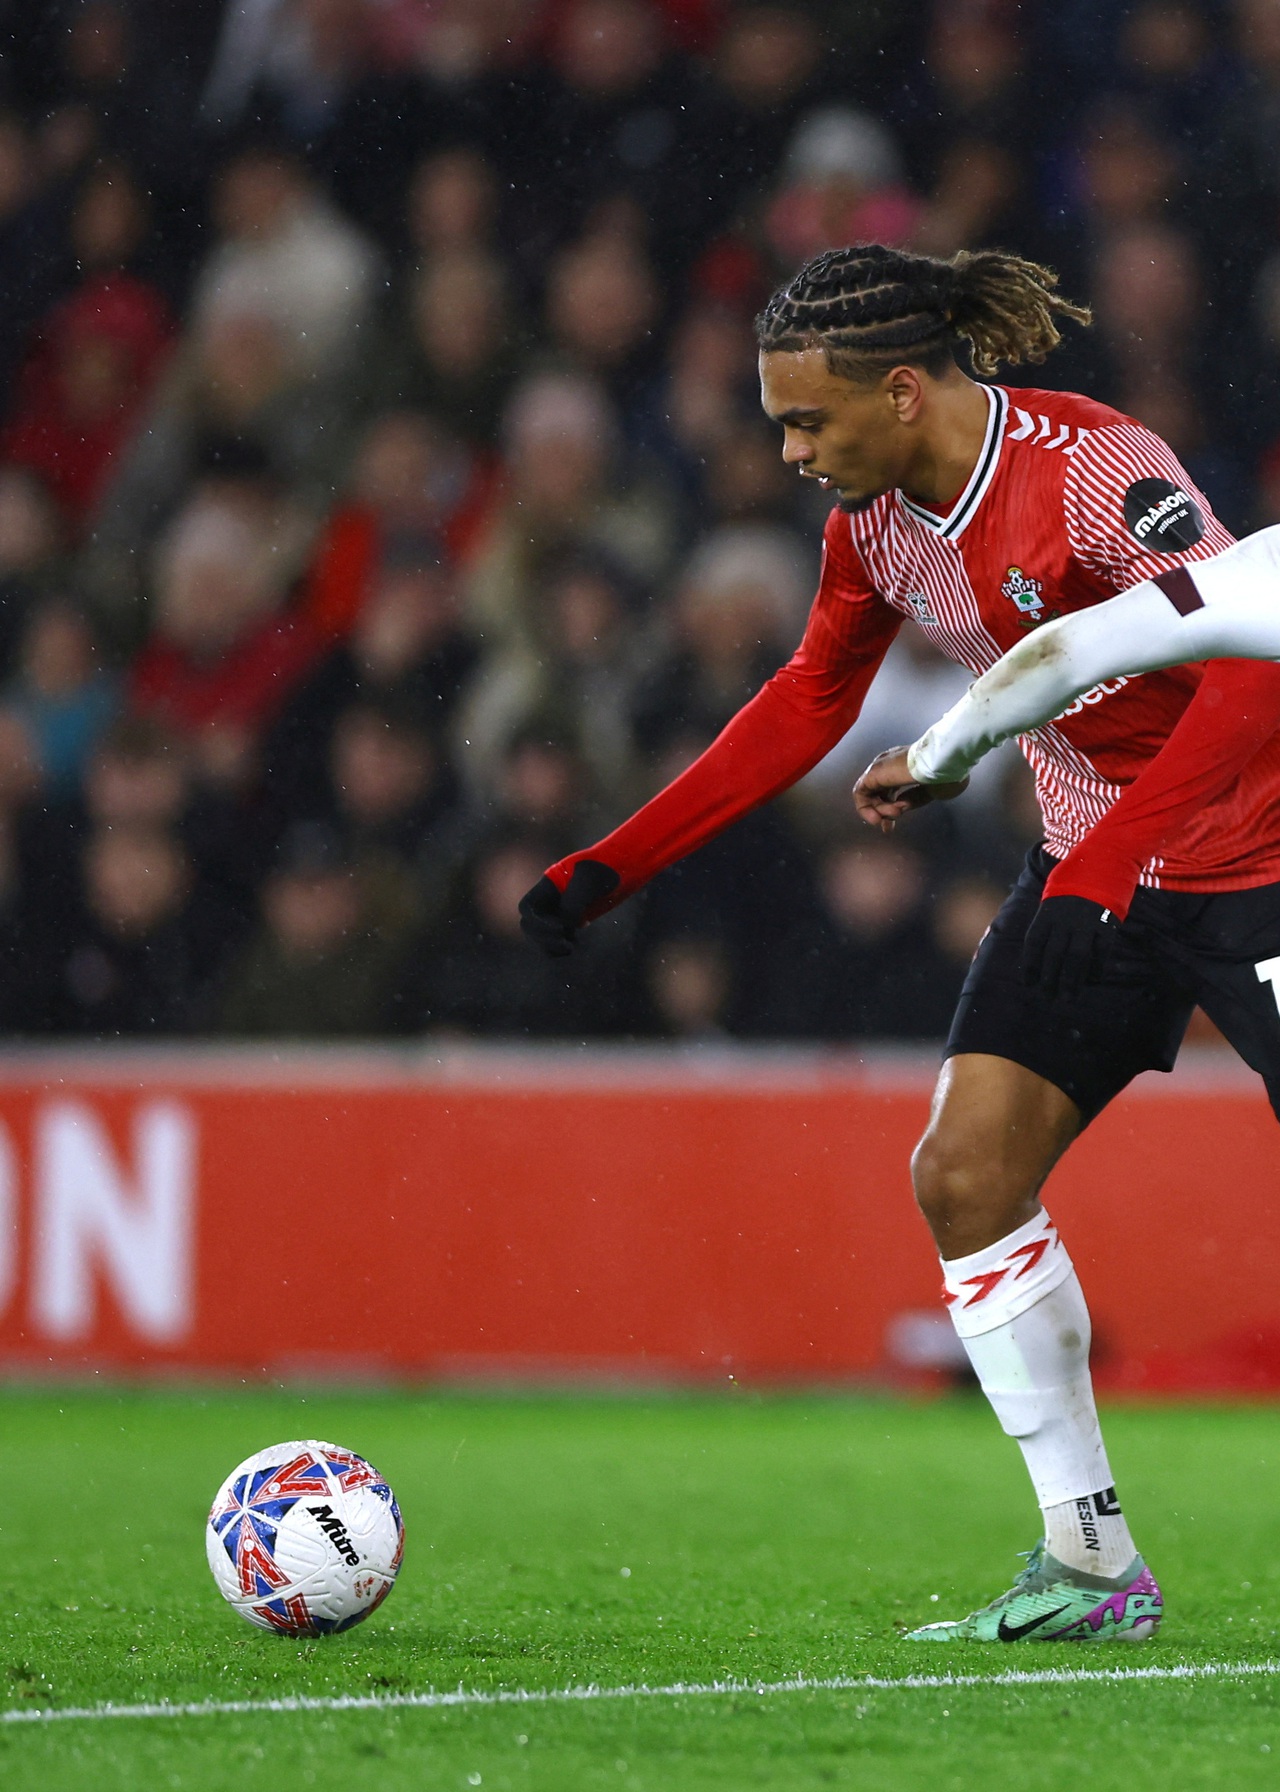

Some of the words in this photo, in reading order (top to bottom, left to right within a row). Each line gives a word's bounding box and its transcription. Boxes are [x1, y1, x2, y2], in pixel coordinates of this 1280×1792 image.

[1157, 513, 1180, 535] FREIGHT
[1178, 508, 1189, 518] UK
[0, 1097, 200, 1346] N
[1075, 1496, 1100, 1551] ESIGN
